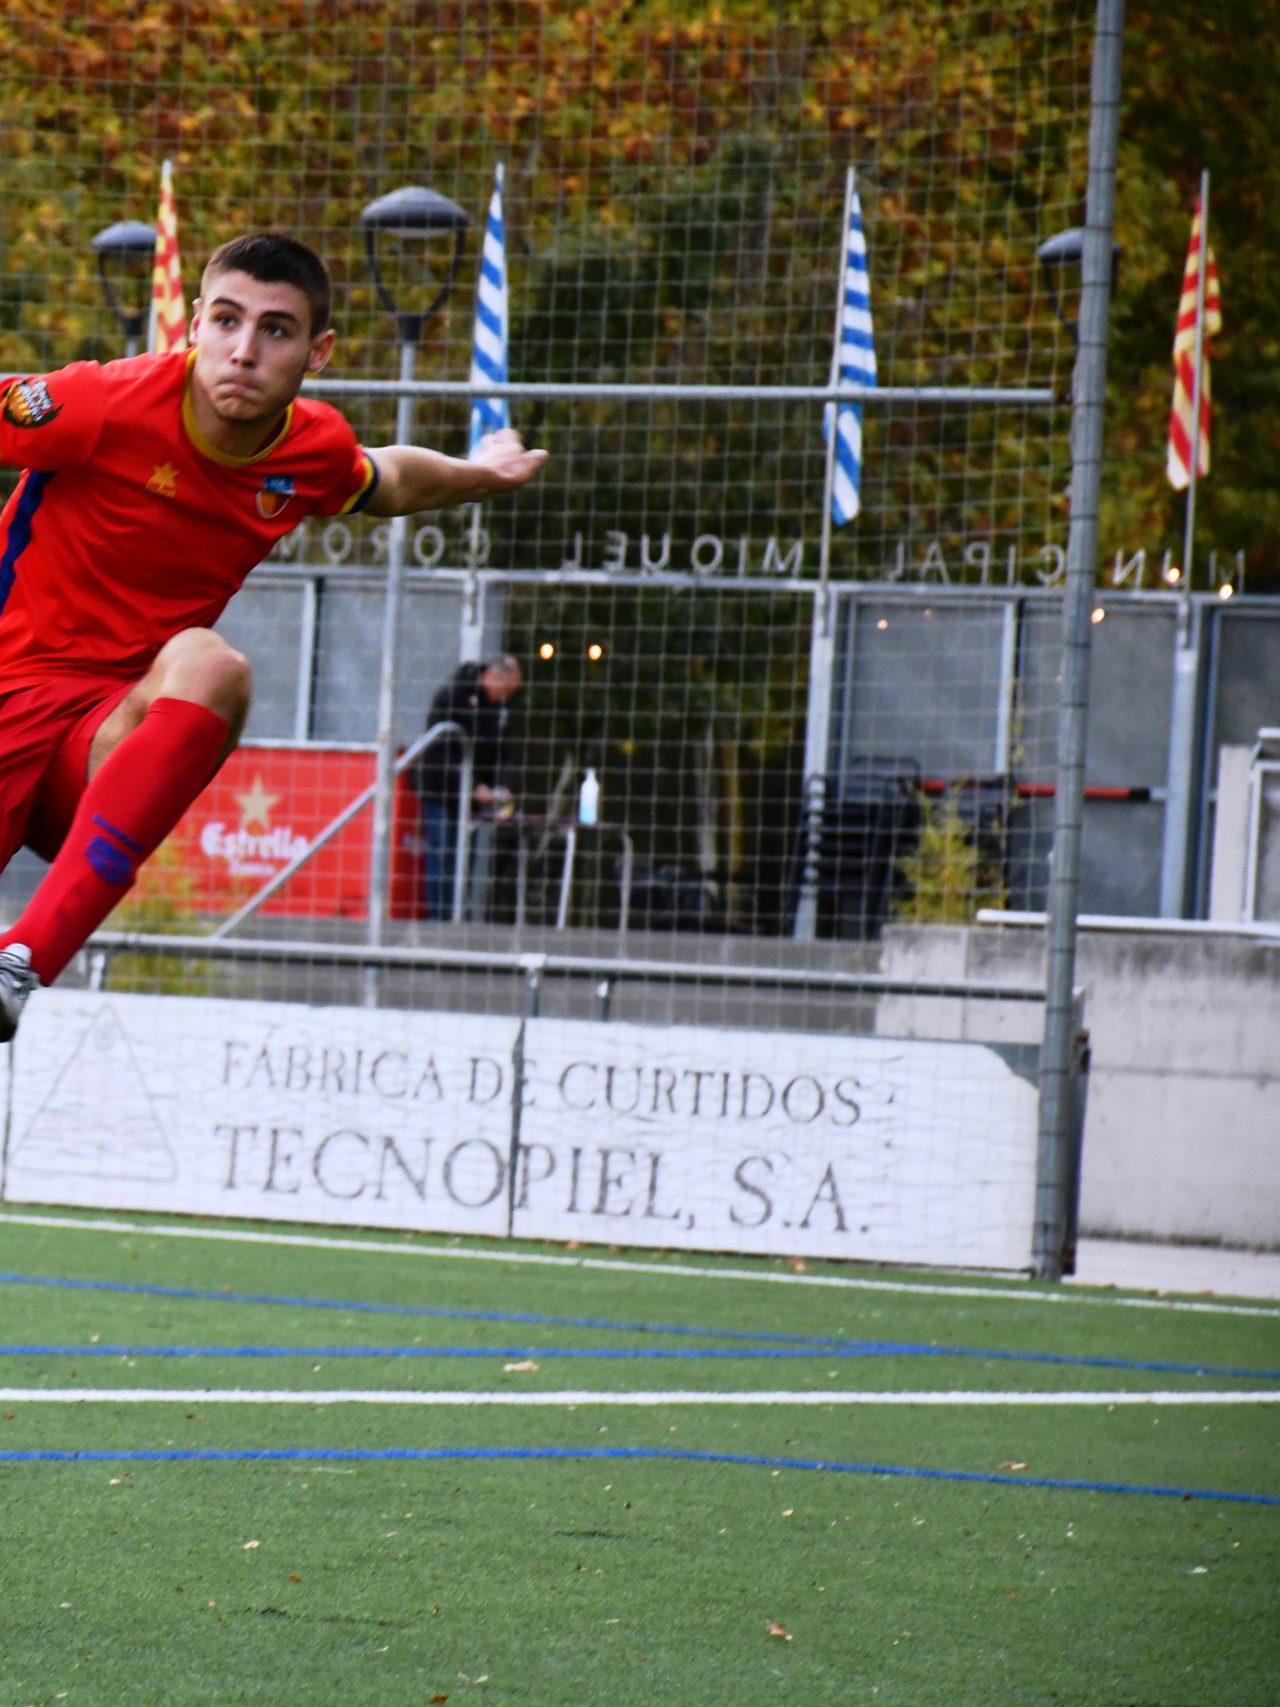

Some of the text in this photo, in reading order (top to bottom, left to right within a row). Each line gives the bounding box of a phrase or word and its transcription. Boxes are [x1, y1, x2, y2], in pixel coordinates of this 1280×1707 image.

[468, 1056, 537, 1107] DE
[558, 1060, 863, 1127] CURTIDOS
[214, 1123, 871, 1235] TECNOPIEL, S.A.
